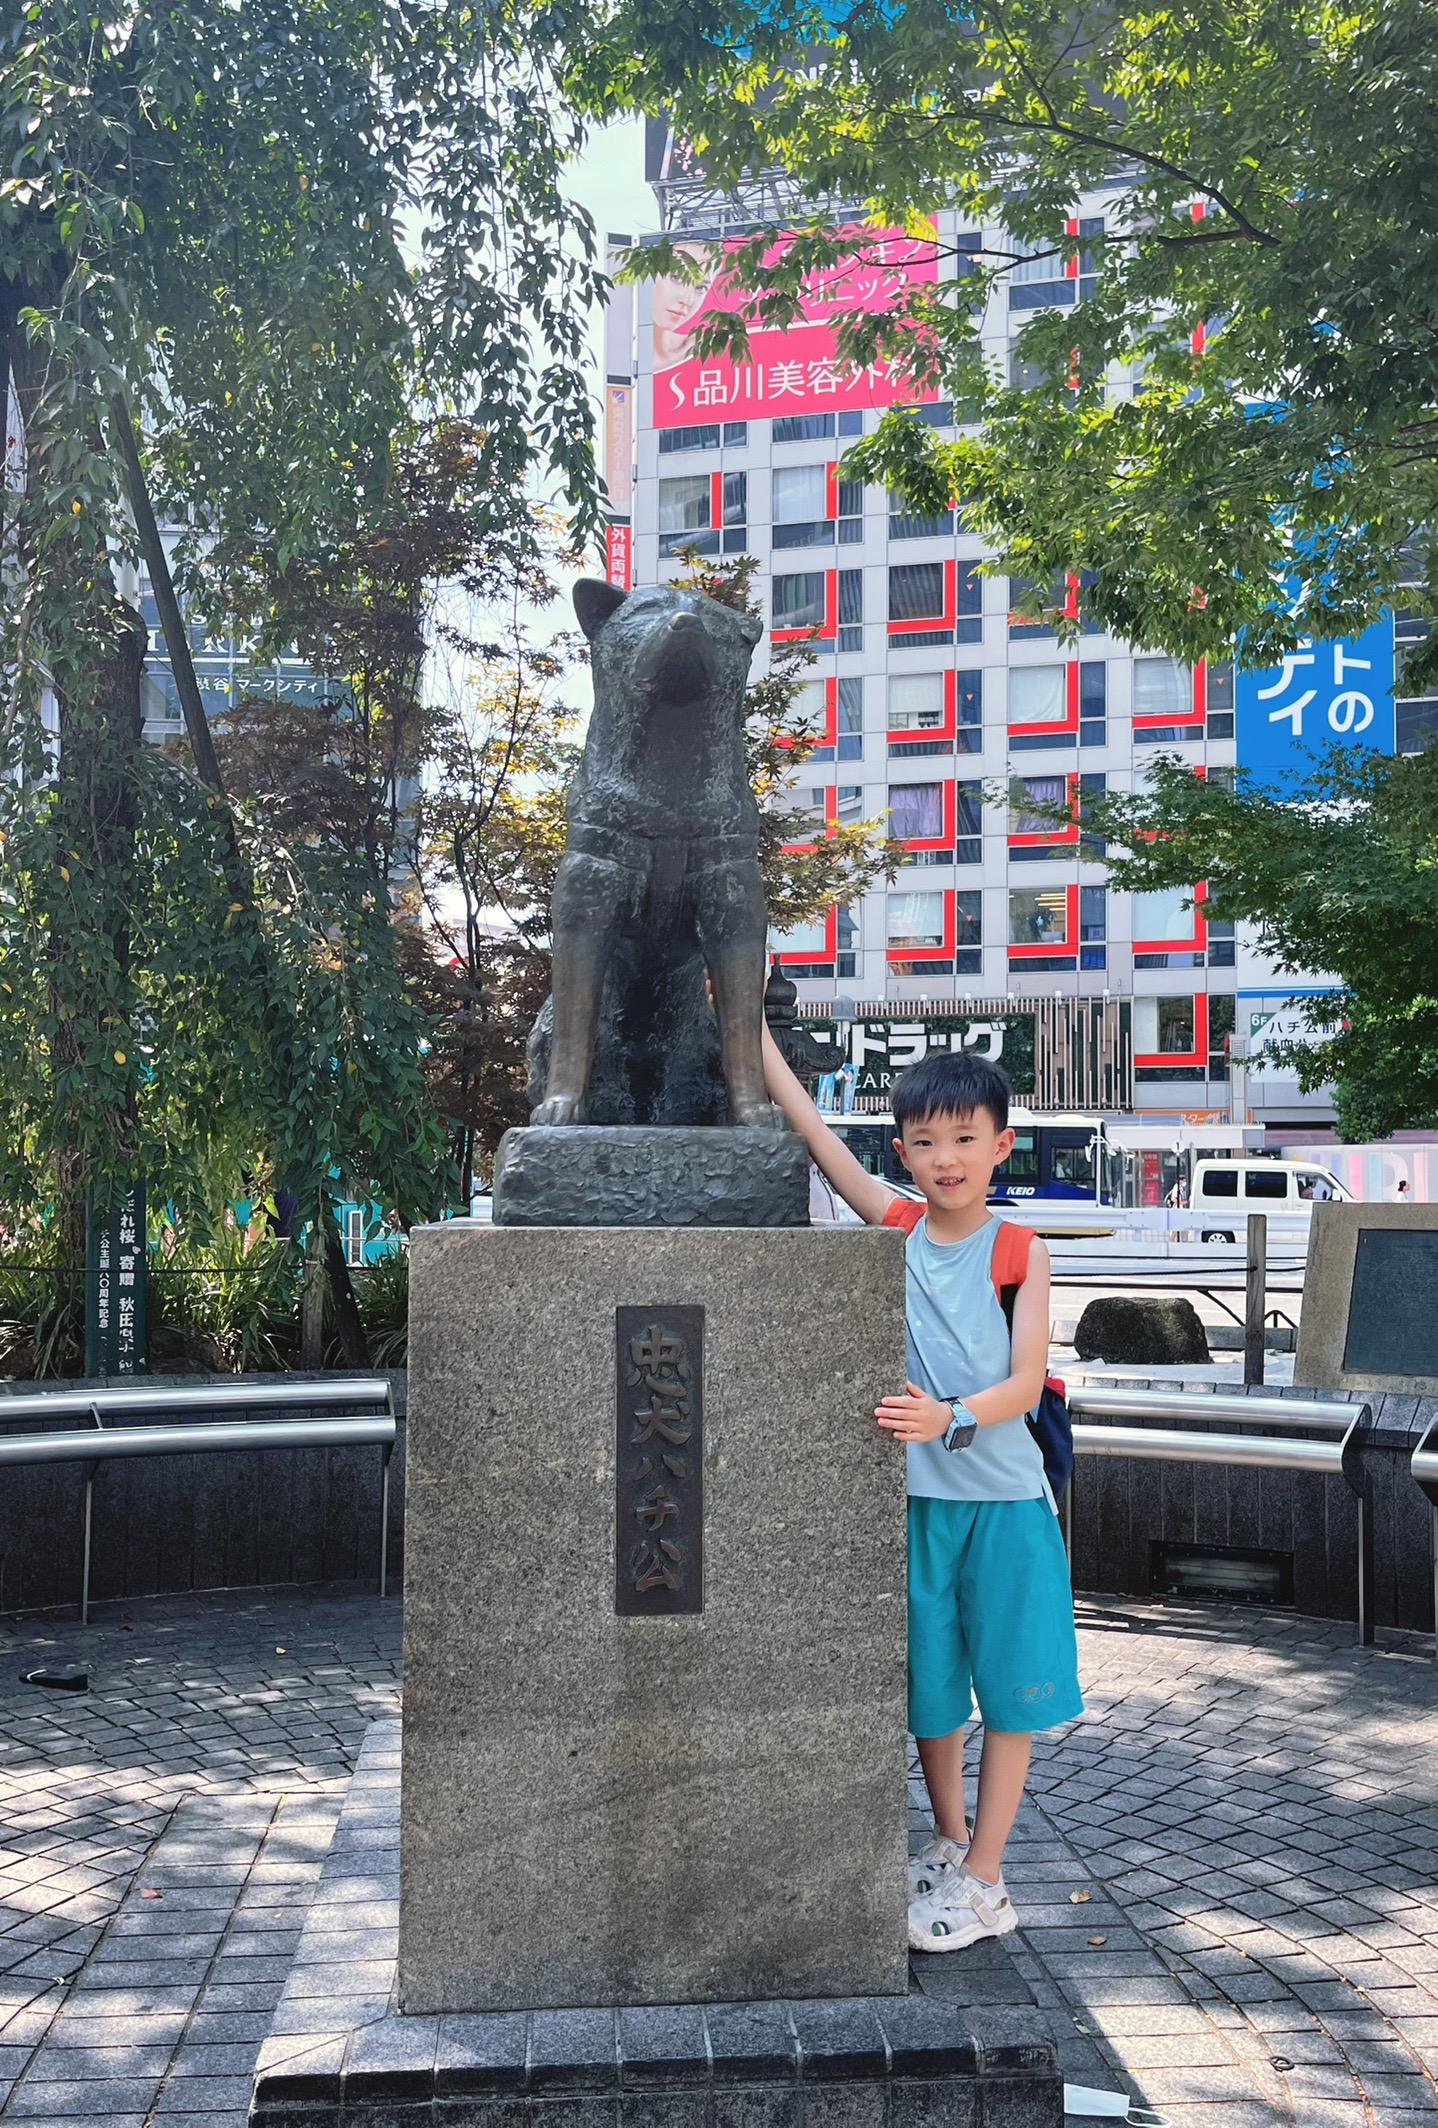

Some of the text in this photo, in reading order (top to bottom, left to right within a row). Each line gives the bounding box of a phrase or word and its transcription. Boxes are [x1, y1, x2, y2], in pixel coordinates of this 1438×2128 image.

[1006, 1186, 1036, 1196] KEIO
[626, 1324, 692, 1592] 忠犬ハチ公
